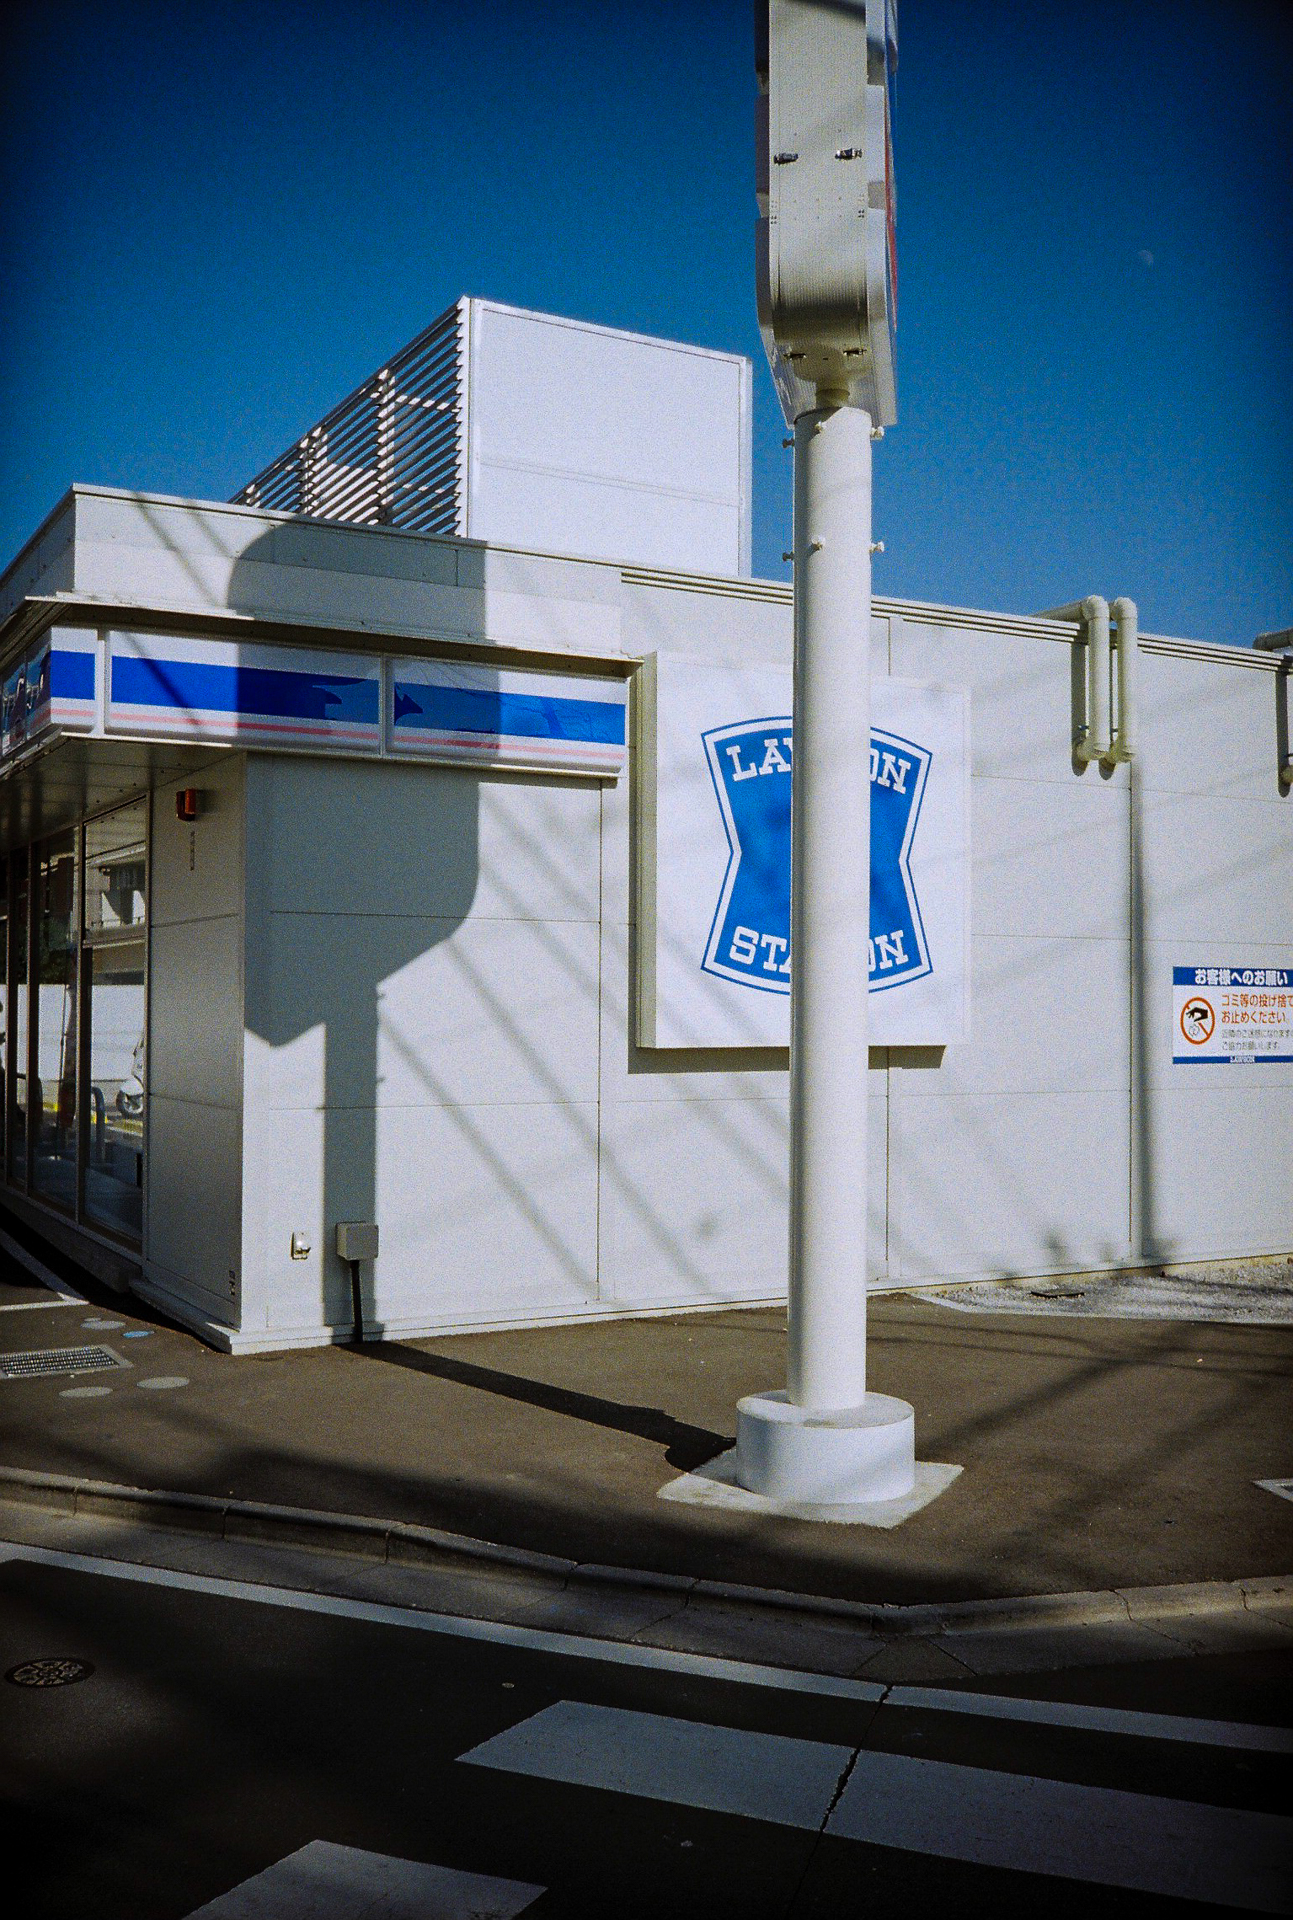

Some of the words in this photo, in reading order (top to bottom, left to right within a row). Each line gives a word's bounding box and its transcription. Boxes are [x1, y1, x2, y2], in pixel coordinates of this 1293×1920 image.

[1194, 968, 1289, 986] お客様へのお願い
